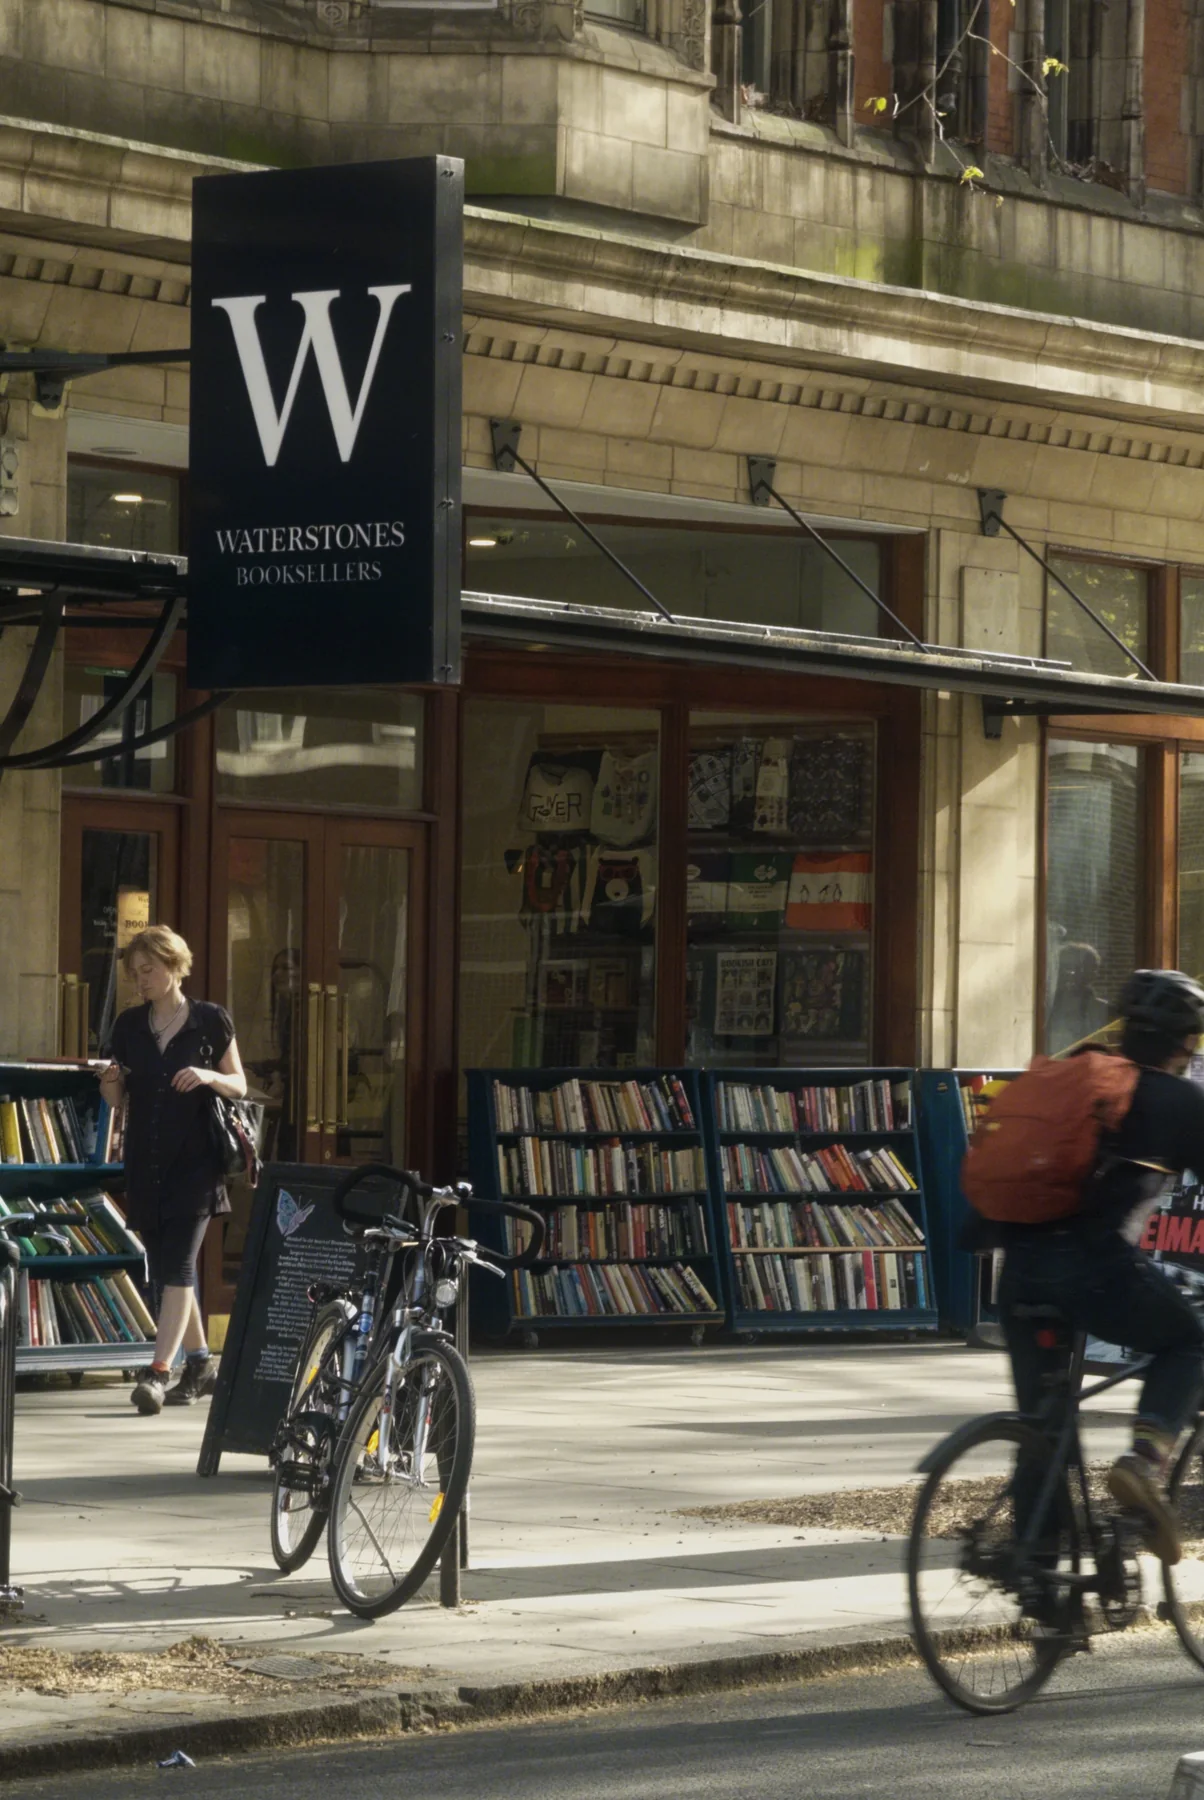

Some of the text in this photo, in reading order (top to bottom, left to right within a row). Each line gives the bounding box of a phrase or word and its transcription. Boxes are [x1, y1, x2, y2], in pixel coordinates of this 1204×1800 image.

[211, 283, 412, 467] W
[216, 521, 405, 554] WATERSTONES
[236, 560, 382, 586] BOOKSELLERS
